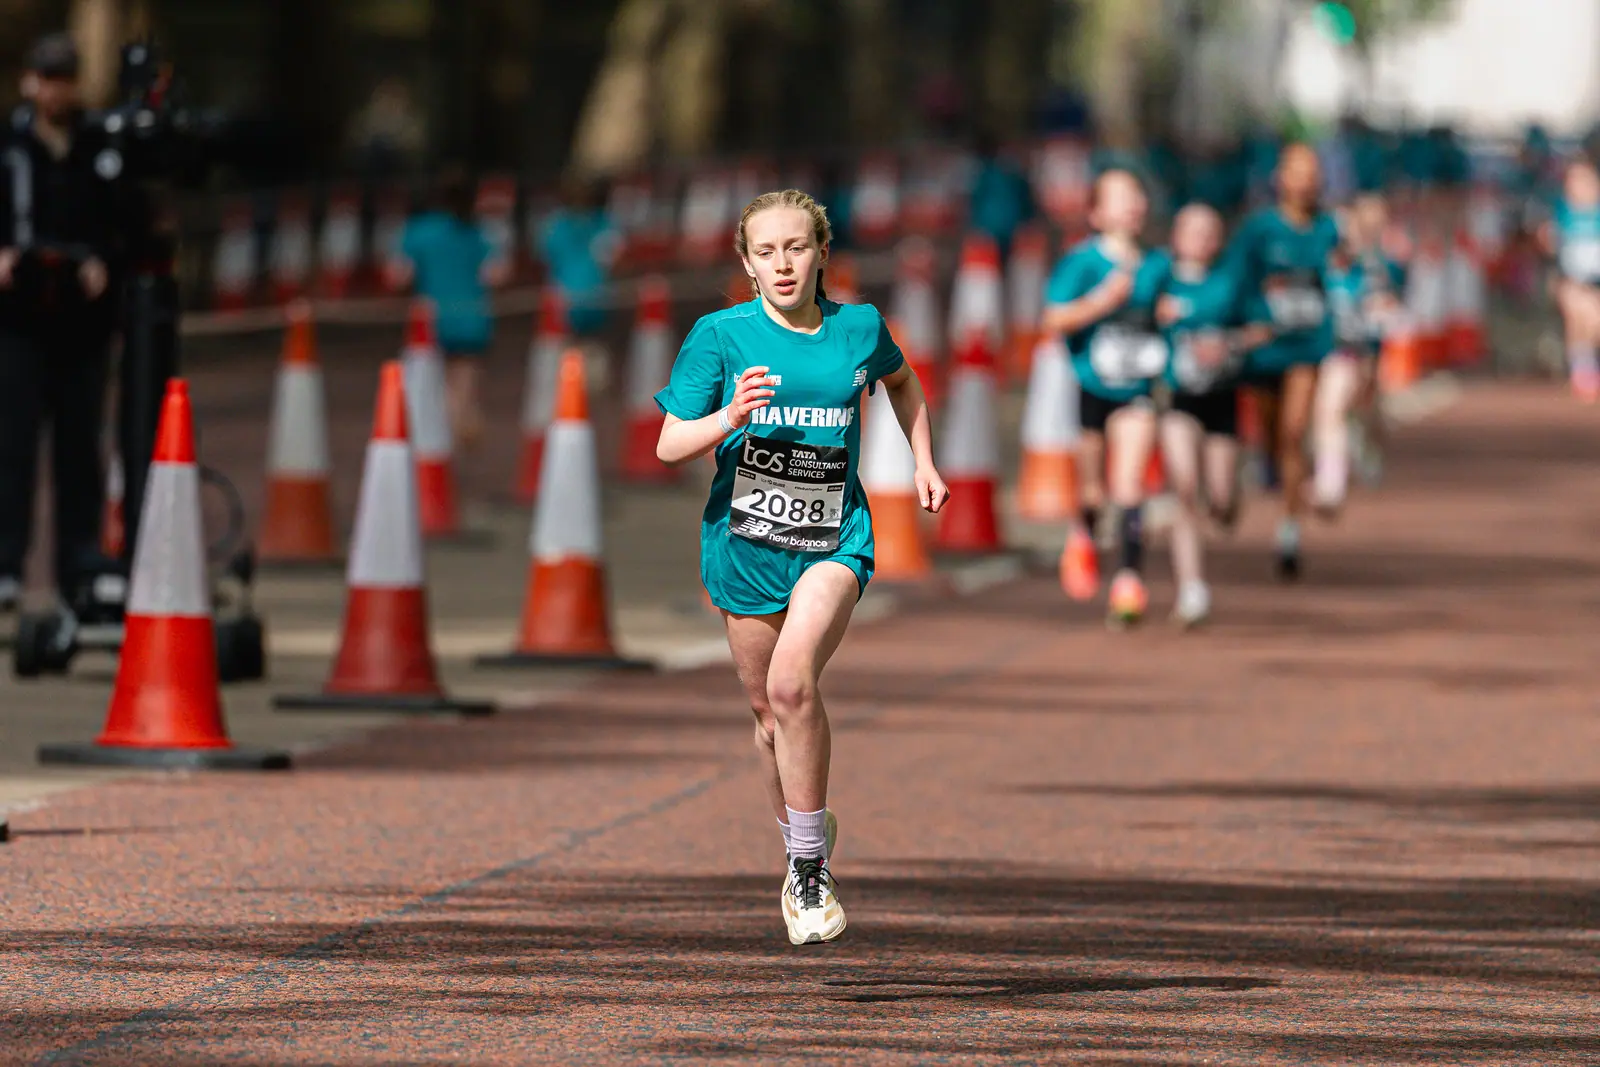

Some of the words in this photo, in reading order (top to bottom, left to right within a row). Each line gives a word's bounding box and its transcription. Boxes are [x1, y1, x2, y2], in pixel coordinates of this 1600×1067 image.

[743, 439, 785, 473] tcs
[790, 449, 817, 460] TATA
[789, 458, 847, 470] CONSULTANCY
[787, 467, 826, 479] SERVICES
[748, 488, 825, 523] 2088
[769, 533, 790, 544] new
[789, 536, 828, 547] balance
